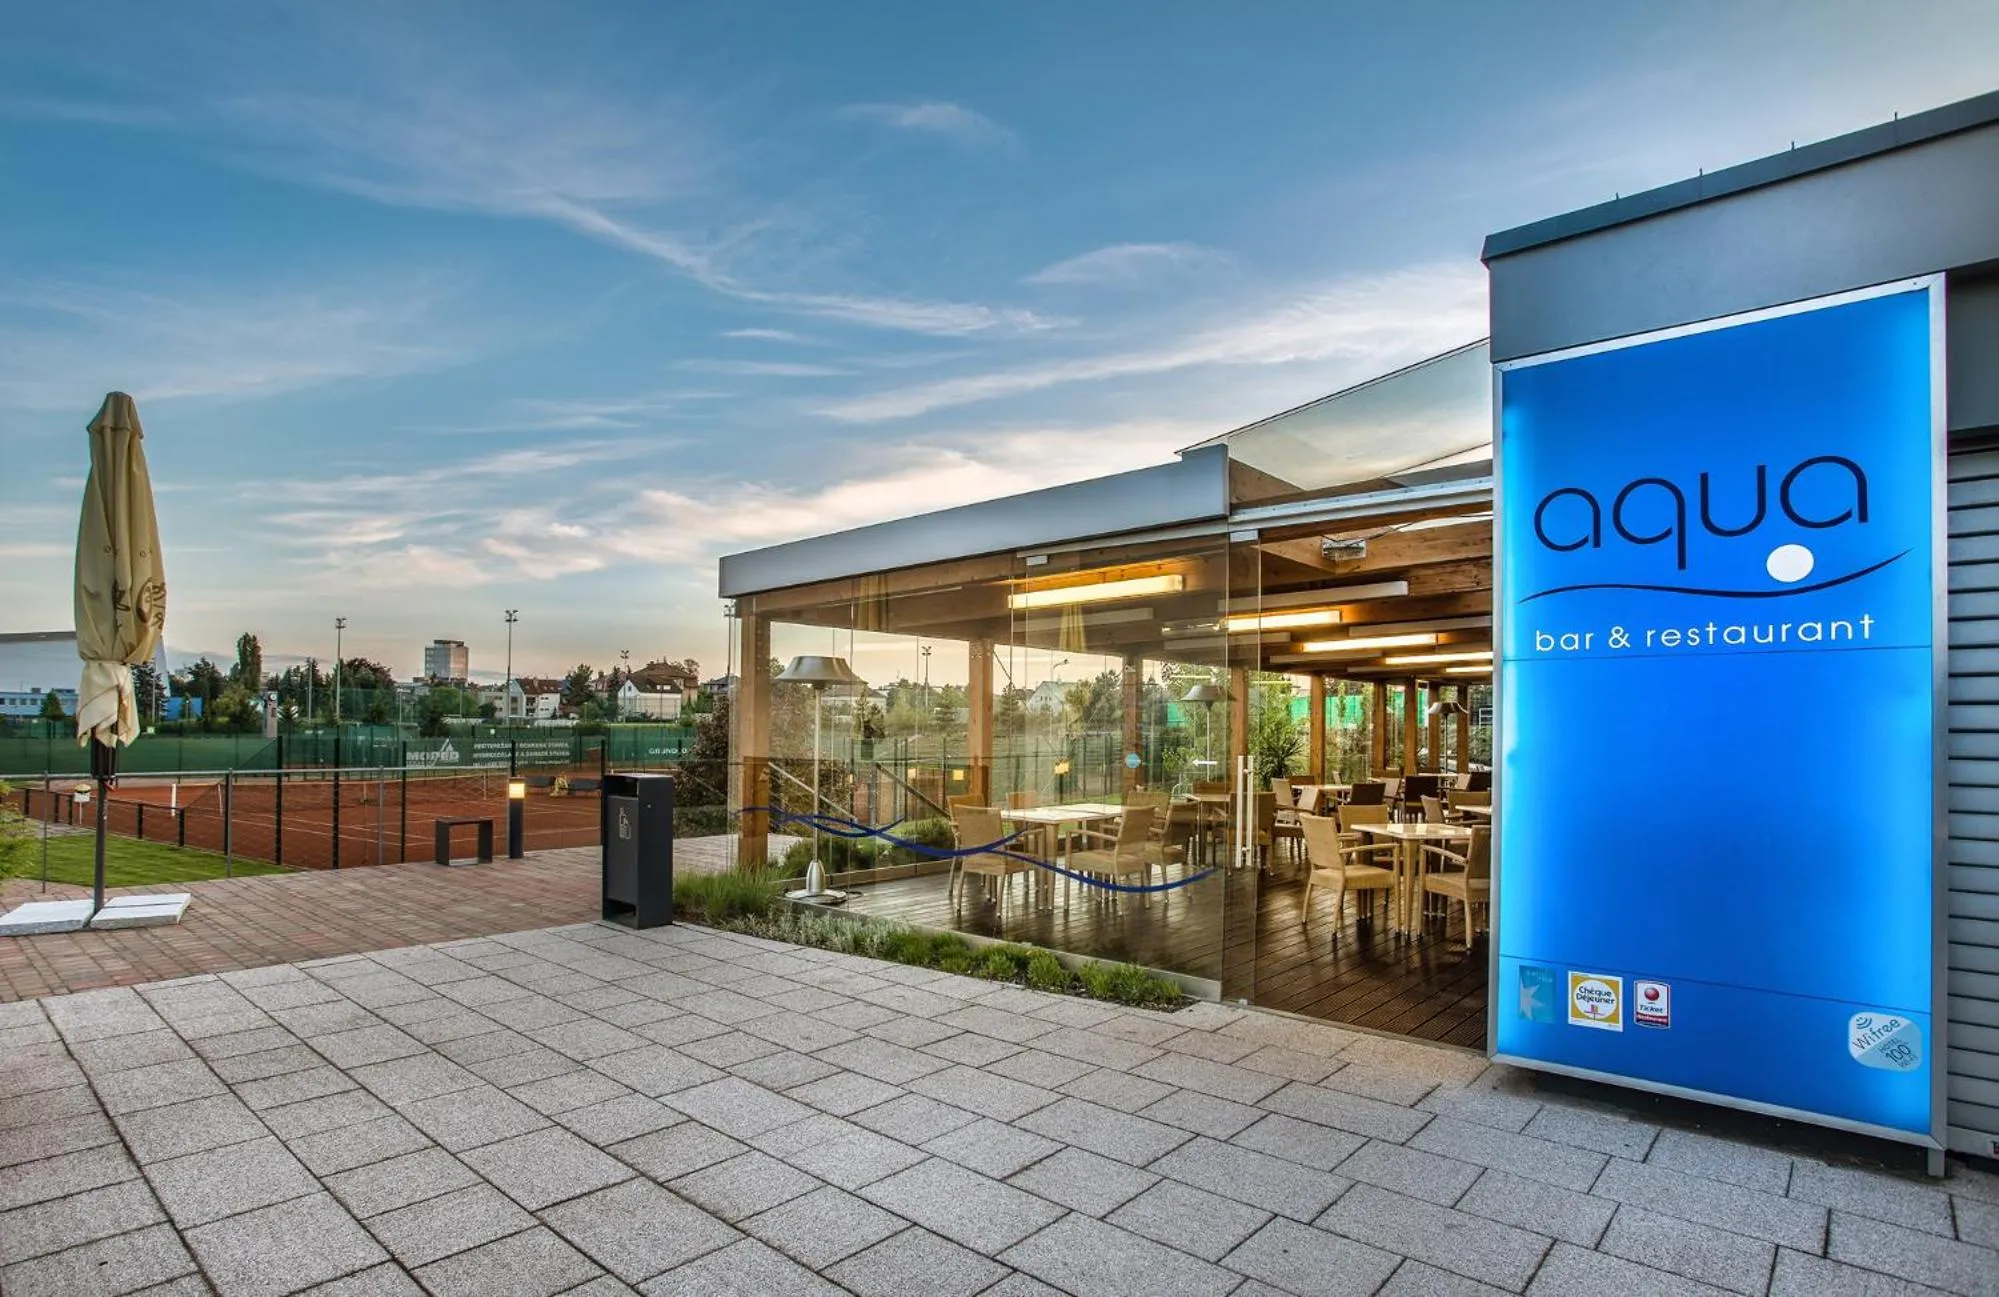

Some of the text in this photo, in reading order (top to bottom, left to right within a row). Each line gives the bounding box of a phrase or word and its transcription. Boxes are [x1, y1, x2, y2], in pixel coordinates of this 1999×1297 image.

[1534, 455, 1869, 570] aqua
[1535, 613, 1876, 652] bar & restaurant
[1639, 1004, 1664, 1014] Ticket
